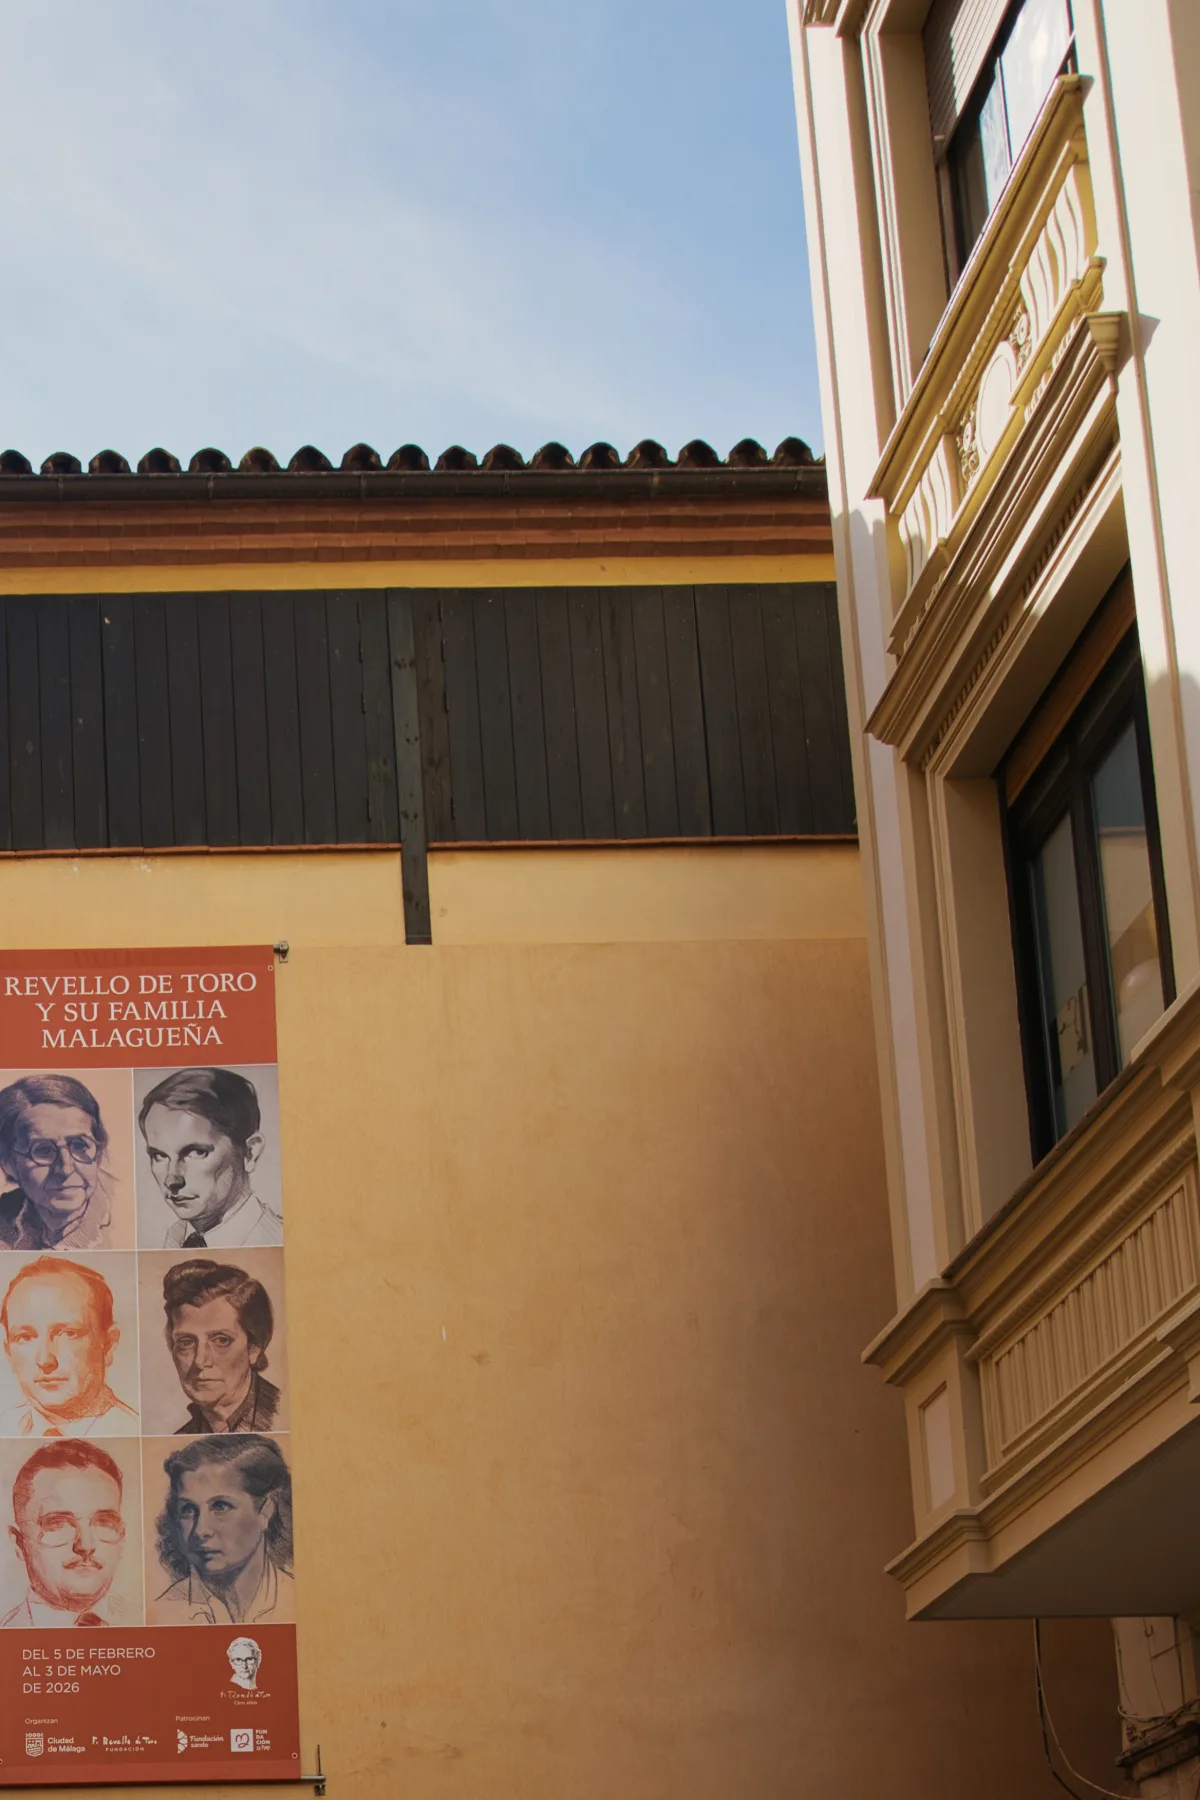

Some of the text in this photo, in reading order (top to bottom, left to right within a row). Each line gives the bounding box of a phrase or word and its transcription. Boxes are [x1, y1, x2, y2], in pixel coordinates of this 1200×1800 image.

[5, 973, 257, 996] REVELLO DE TORO
[36, 1000, 227, 1022] Y SU FAMILIA
[42, 1023, 223, 1049] MALAGUEÑA
[23, 1647, 155, 1660] DEL 5 DE FEBRERO
[23, 1665, 121, 1677] AL 3 DE MAYO
[23, 1682, 80, 1694] DE 2026
[59, 1745, 85, 1753] Málaga
